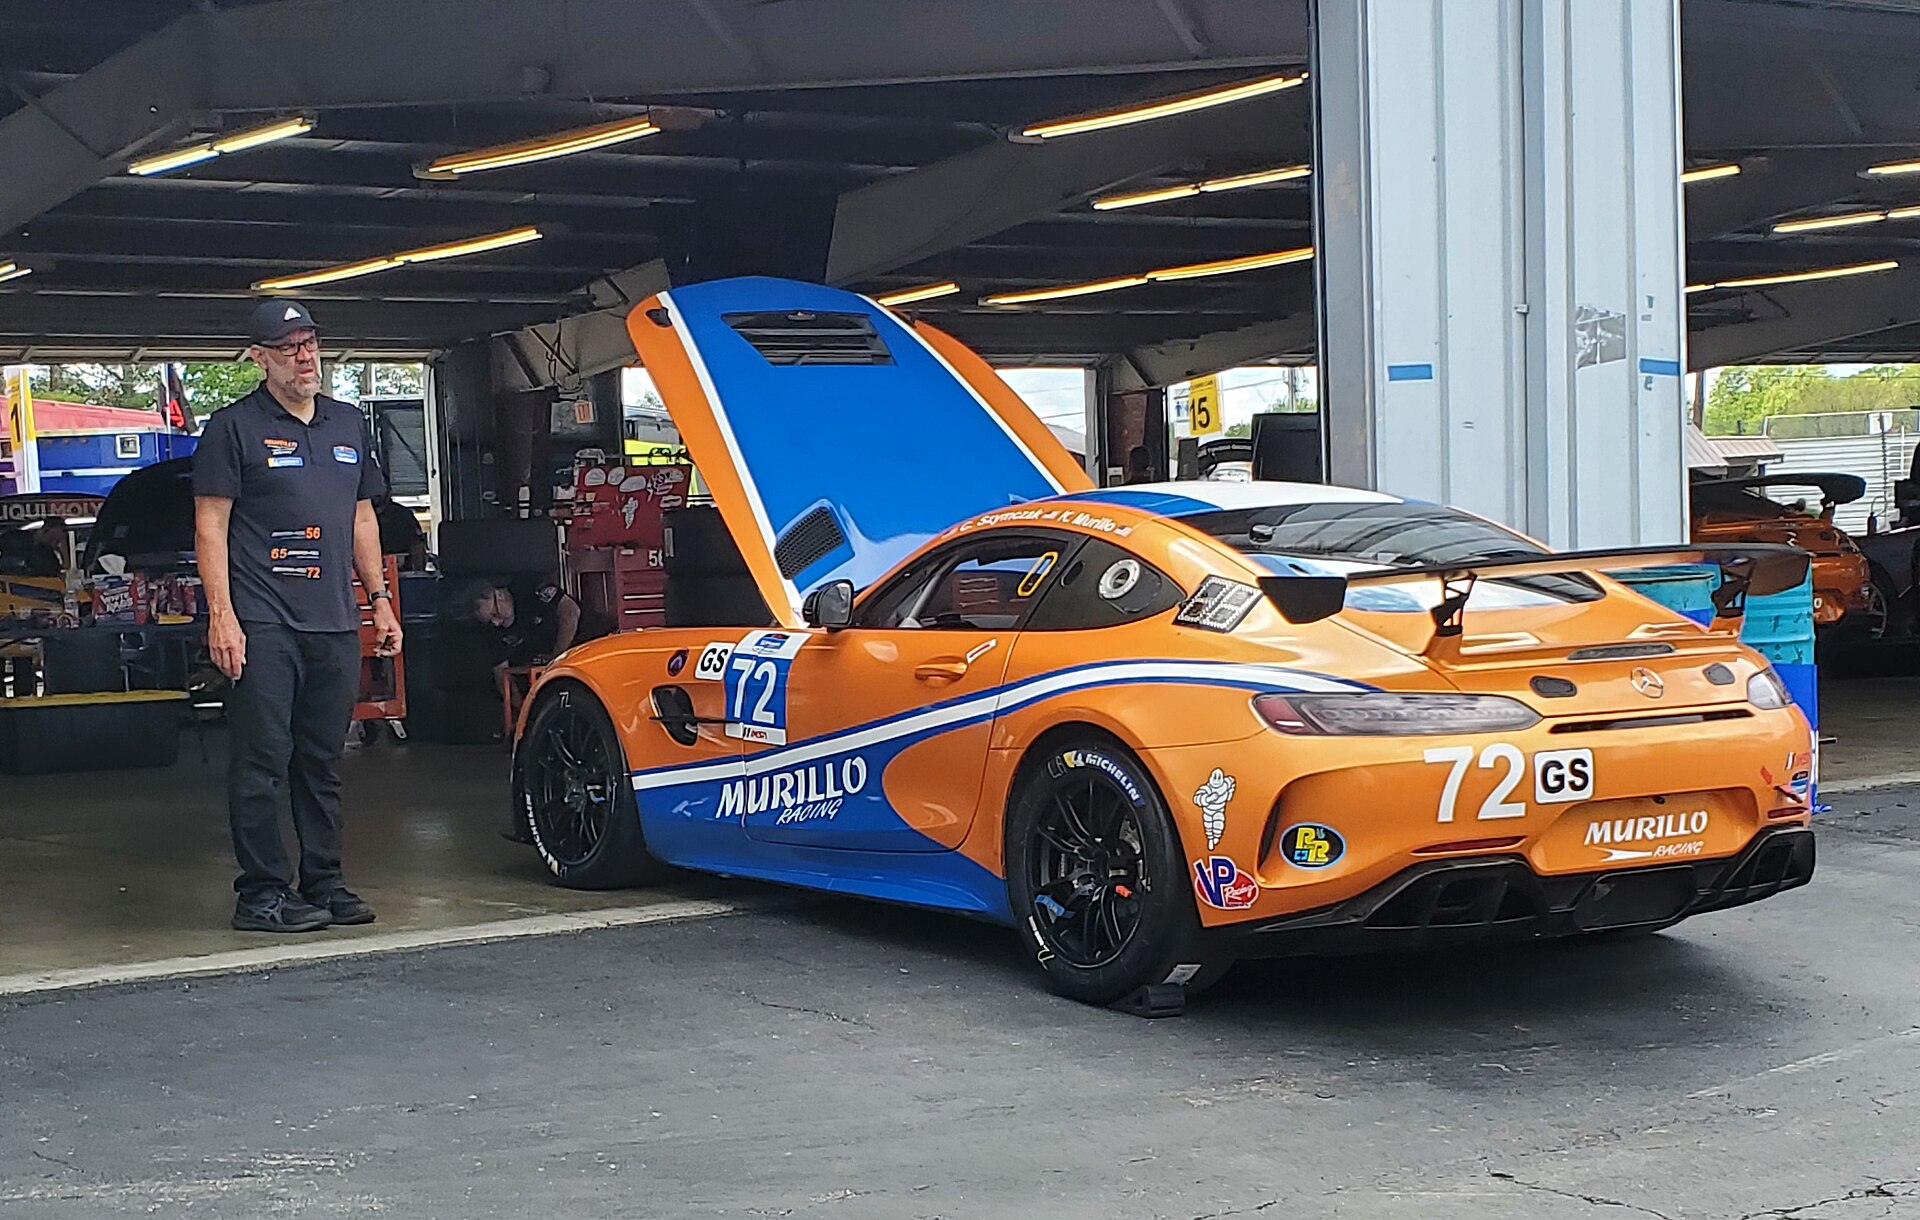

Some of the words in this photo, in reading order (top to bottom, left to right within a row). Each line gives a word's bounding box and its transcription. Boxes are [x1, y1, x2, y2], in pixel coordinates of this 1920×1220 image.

[1190, 396, 1211, 431] 15
[50, 502, 105, 519] MOLY
[1072, 511, 1117, 532] Murillo
[270, 548, 288, 560] 65
[307, 567, 321, 579] 72
[700, 647, 729, 673] GS
[732, 657, 778, 724] 72
[715, 756, 868, 819] MURILLO
[1085, 753, 1140, 801] MICHELIN
[1423, 743, 1527, 823] 72
[1540, 758, 1590, 794] GS
[776, 798, 844, 826] RACING
[1583, 809, 1709, 847] MURILLO
[1652, 841, 1705, 858] RACING
[1193, 856, 1237, 908] VP
